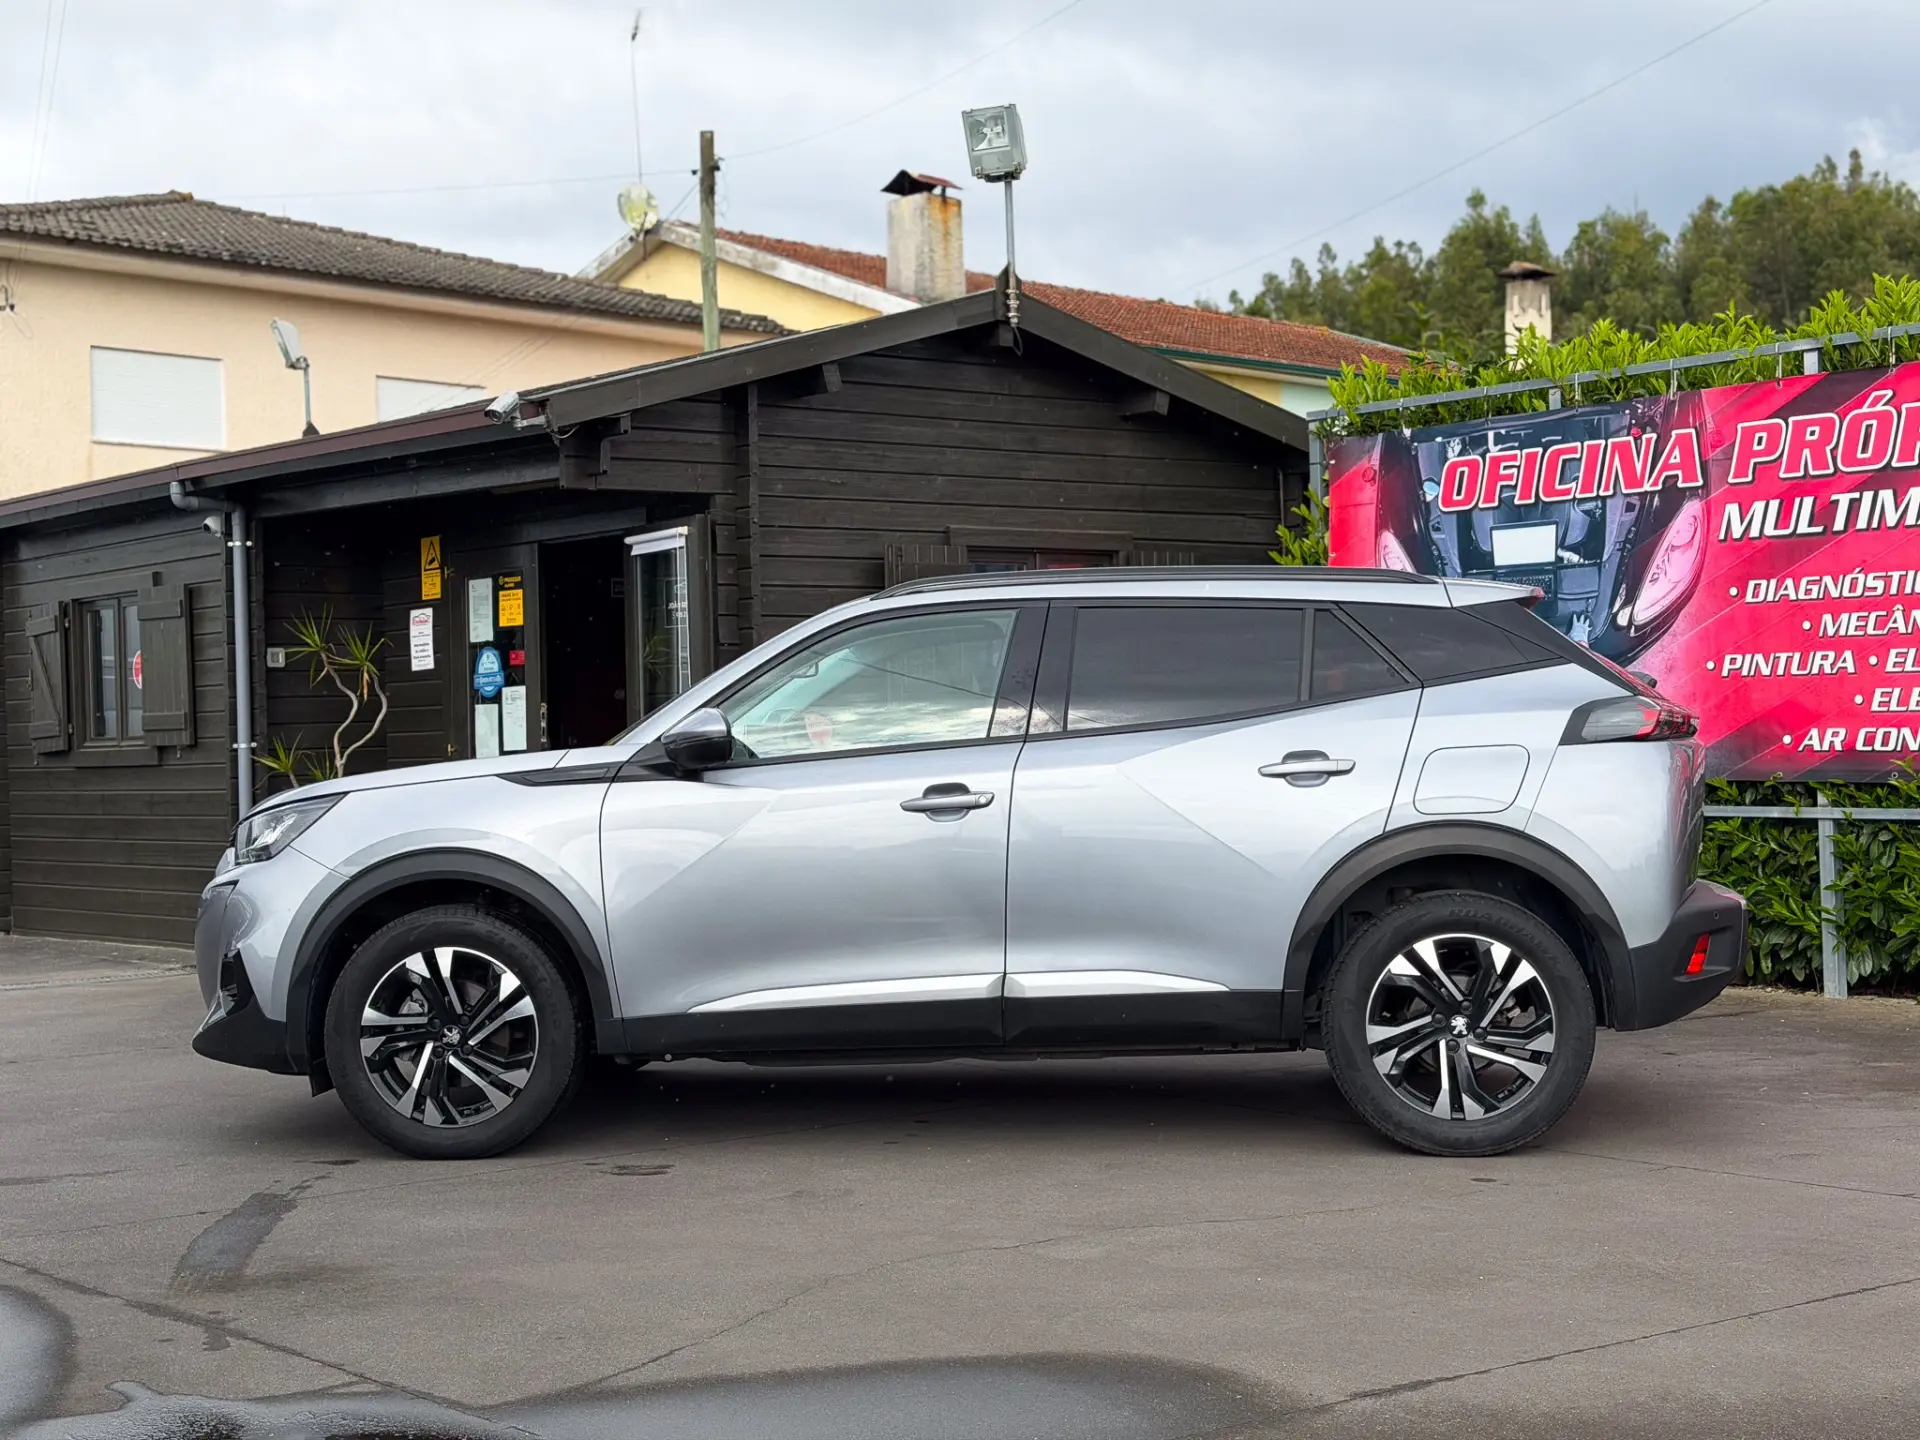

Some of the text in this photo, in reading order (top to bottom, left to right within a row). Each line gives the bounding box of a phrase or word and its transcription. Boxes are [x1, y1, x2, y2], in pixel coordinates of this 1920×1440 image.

[1437, 427, 1704, 513] OFICINA
[1718, 486, 1920, 541] MULTIM
[1721, 650, 1856, 677] PINTURA
[1797, 727, 1920, 752] AR CON
